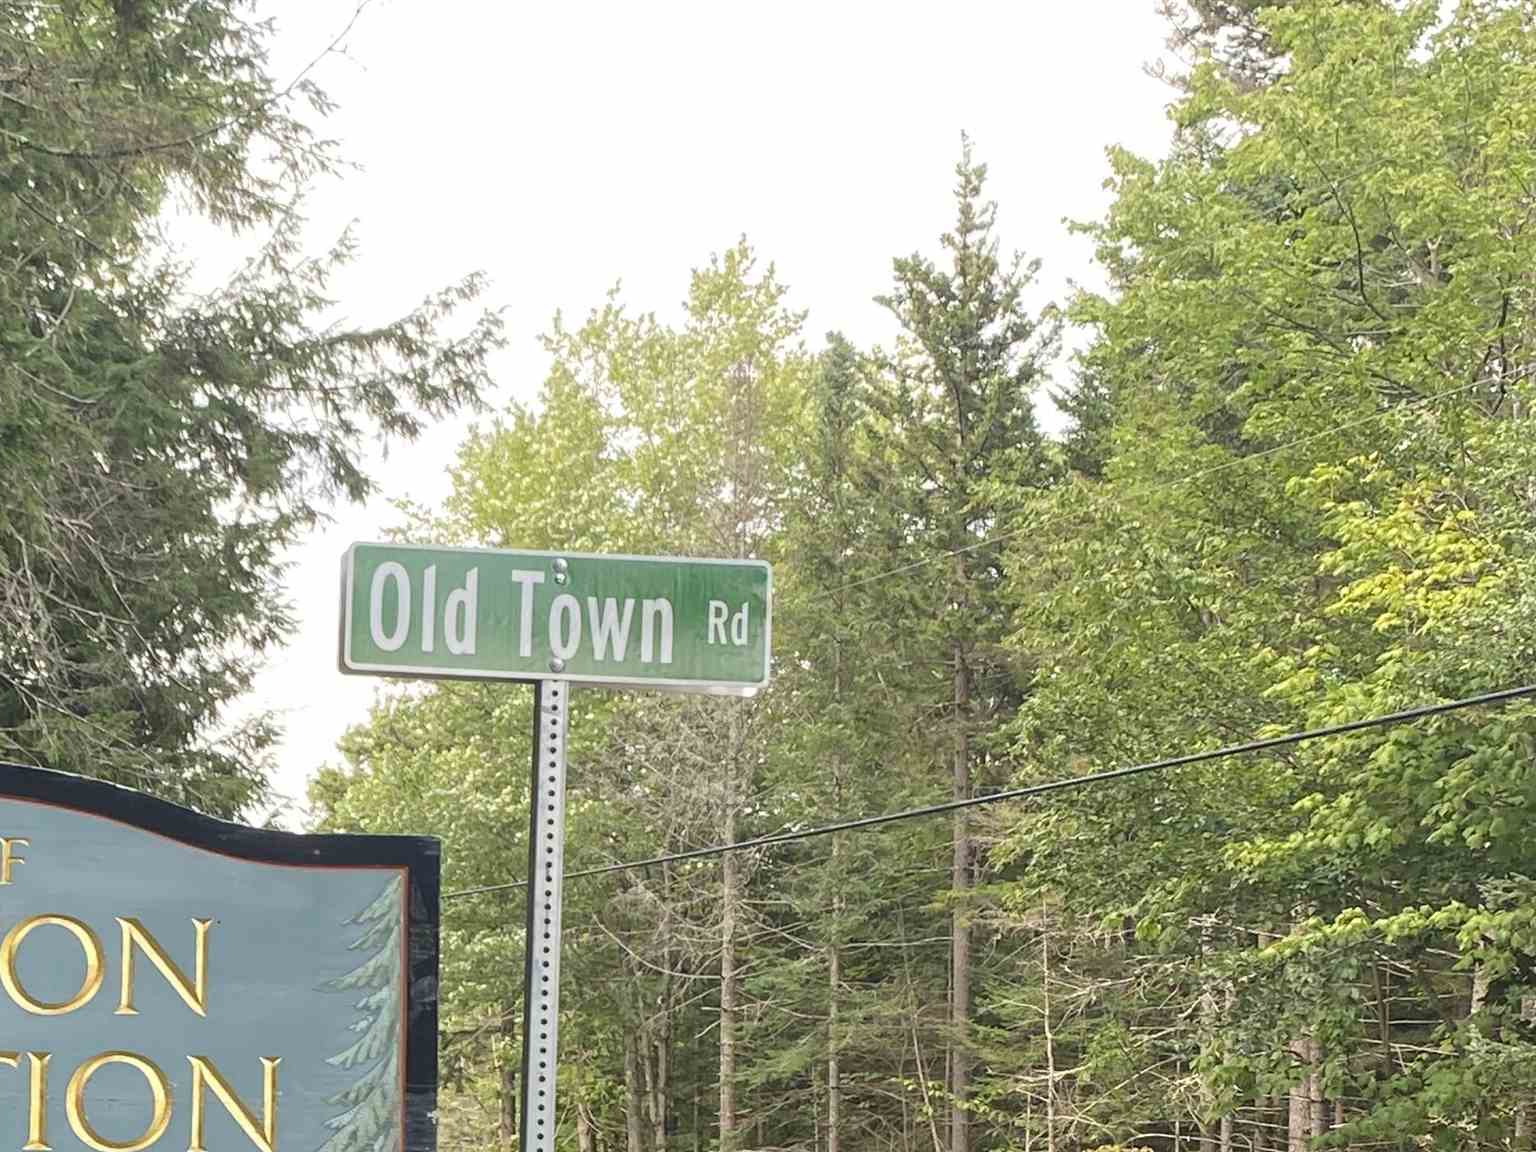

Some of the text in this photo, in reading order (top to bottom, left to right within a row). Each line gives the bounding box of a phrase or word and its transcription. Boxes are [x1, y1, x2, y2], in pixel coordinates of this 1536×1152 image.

[369, 561, 750, 664] Old Town Rd
